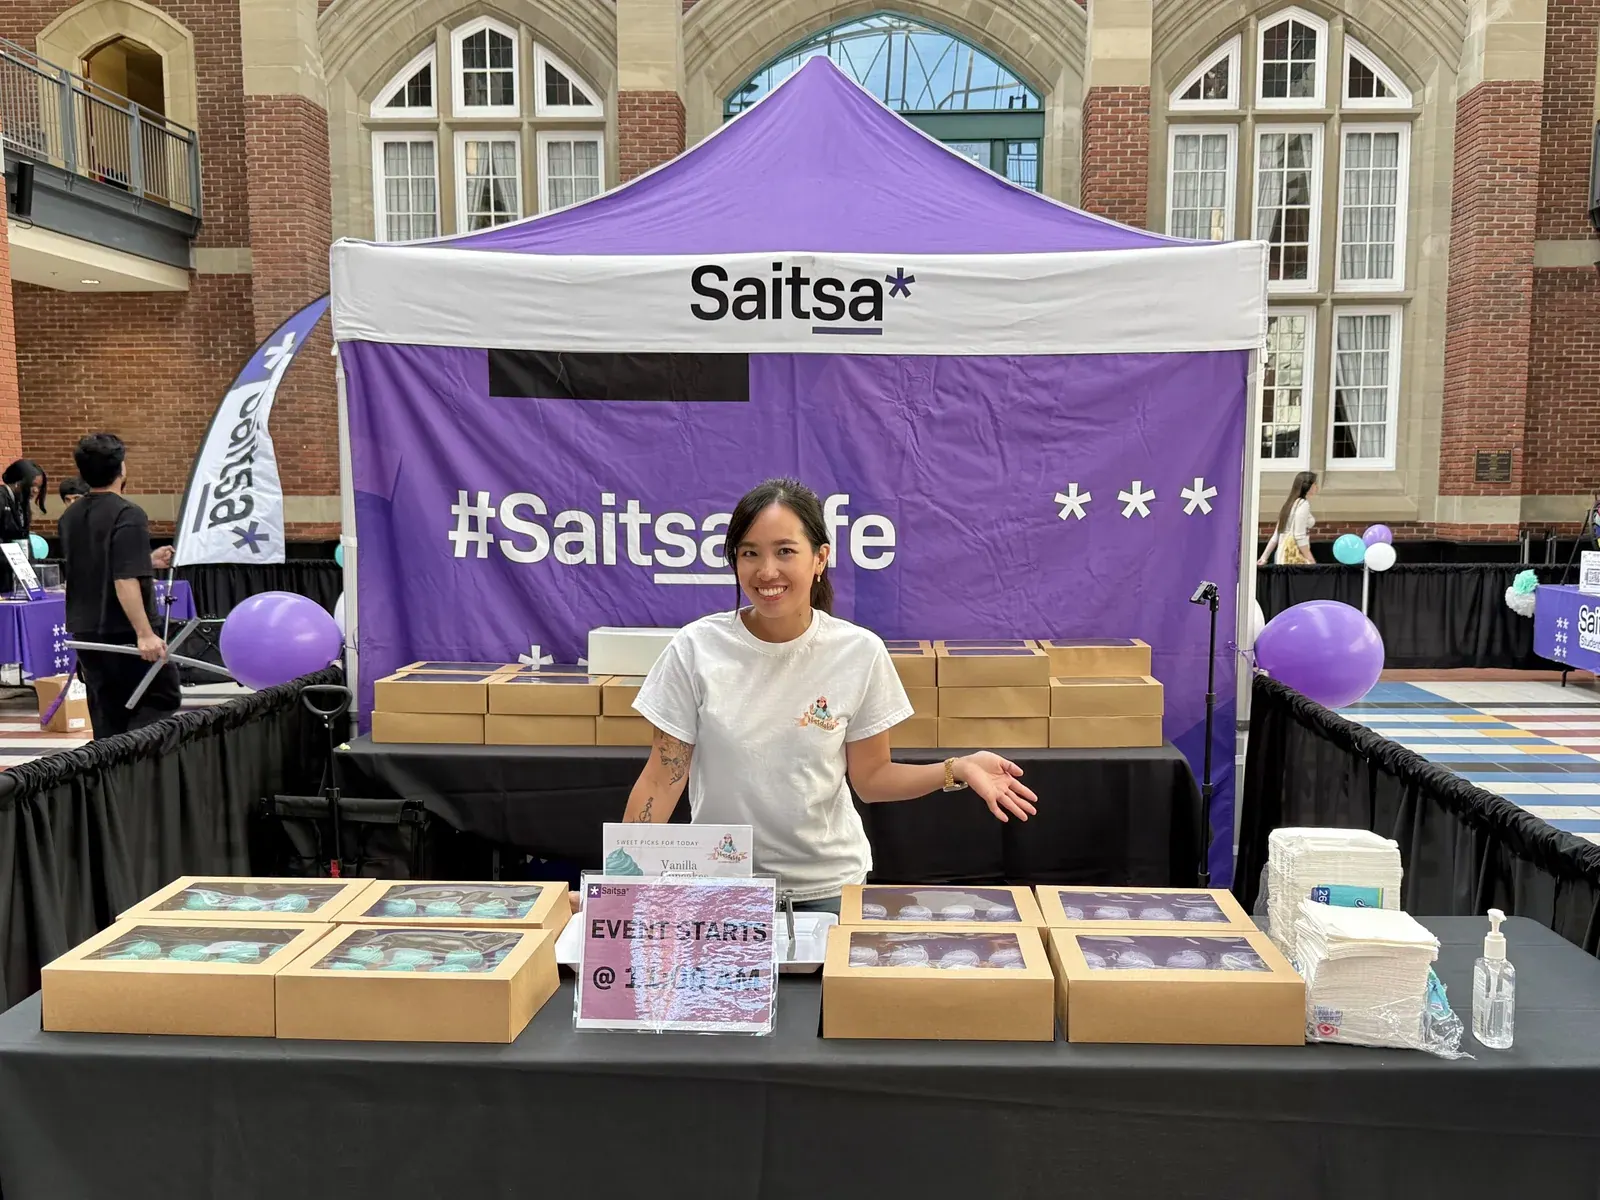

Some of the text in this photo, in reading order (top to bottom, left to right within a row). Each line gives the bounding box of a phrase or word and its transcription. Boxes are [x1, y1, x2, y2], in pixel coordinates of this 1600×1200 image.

[660, 859, 698, 870] Vanilla
[591, 919, 767, 942] EVENT STARTS
[592, 966, 616, 990] @
